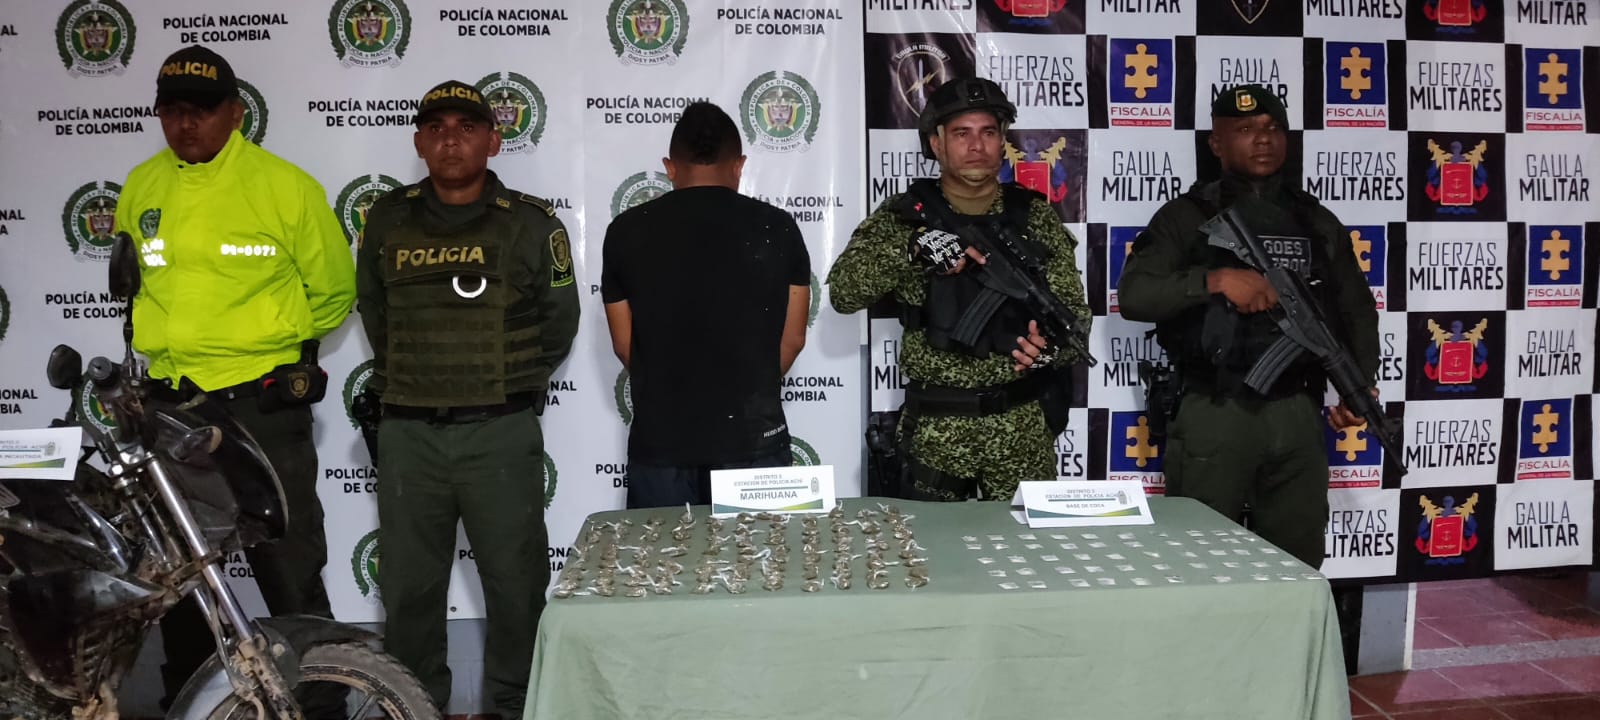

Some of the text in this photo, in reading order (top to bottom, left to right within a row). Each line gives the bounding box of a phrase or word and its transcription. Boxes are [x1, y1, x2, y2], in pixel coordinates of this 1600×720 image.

[440, 8, 568, 21] POLICÍA NACIONAL
[717, 7, 843, 21] POLICÍA NACIONAL
[1307, 0, 1403, 18] MILITARES
[1518, 1, 1588, 25] MILITAR
[163, 13, 288, 29] POLICÍA NACIONAL
[735, 23, 825, 35] DE COLOMBIA
[181, 28, 271, 44] DE COLOMBIA
[458, 24, 551, 37] DE COLOMBIA
[161, 61, 219, 81] POLICIA
[990, 55, 1074, 81] FUERZAS
[1220, 58, 1280, 83] GAULA
[1419, 61, 1494, 87] FUERZAS
[423, 86, 482, 104] POLICIA
[586, 95, 638, 109] POLICÍA
[999, 82, 1085, 107] LITARES
[1410, 86, 1503, 112] MILITARES
[308, 97, 420, 112] POLICÍA NACION
[1110, 106, 1171, 116] FISCALÍA
[1326, 106, 1386, 117] FISCALÍA
[38, 106, 160, 122] POLICÍA NACIONAL
[326, 113, 417, 127] DE COLOMBIA
[605, 113, 681, 124] DE COLOMB
[1525, 111, 1583, 121] FISCALÍA
[55, 121, 144, 136] DE COLOMBIA
[881, 151, 940, 177] FUERZ
[1112, 151, 1173, 176] GAULA
[1317, 151, 1396, 176] FUERZAS
[1527, 154, 1583, 178] GAULA
[1102, 177, 1182, 201] MILITAR
[1307, 176, 1405, 200] MILITARES
[1519, 178, 1590, 202] MILITAR
[776, 196, 843, 208] NACIONAL
[796, 211, 825, 223] MBIA
[1263, 240, 1303, 256] GOES
[1419, 242, 1497, 267] FUERZAS
[395, 246, 486, 270] POLICIA
[1409, 266, 1504, 291] MILITARES
[45, 290, 96, 305] POLICÍA
[1527, 288, 1581, 297] FISCALÍA
[63, 306, 127, 319] DE COLOM
[1527, 329, 1576, 354] GAULA
[1111, 338, 1169, 363] GAULA
[1518, 352, 1582, 378] MILITAR
[781, 376, 844, 388] NACIONAL
[0, 389, 39, 400] IONAL
[780, 391, 827, 402] LOMBIA
[1416, 419, 1492, 445] FUERZAS
[1406, 442, 1497, 469] MILITARES
[325, 466, 377, 480] POLICÍA
[595, 464, 629, 475] POLI
[1328, 467, 1380, 479] ISCALÍA
[1518, 459, 1570, 471] FISCALÍA
[343, 483, 360, 494] DE
[613, 478, 629, 488] DE
[740, 490, 798, 501] MARIHUANA
[1516, 501, 1570, 526] GAULA
[1325, 509, 1387, 535] UERZAS
[1508, 523, 1580, 549] MILITAR
[1324, 532, 1394, 558] LITARES
